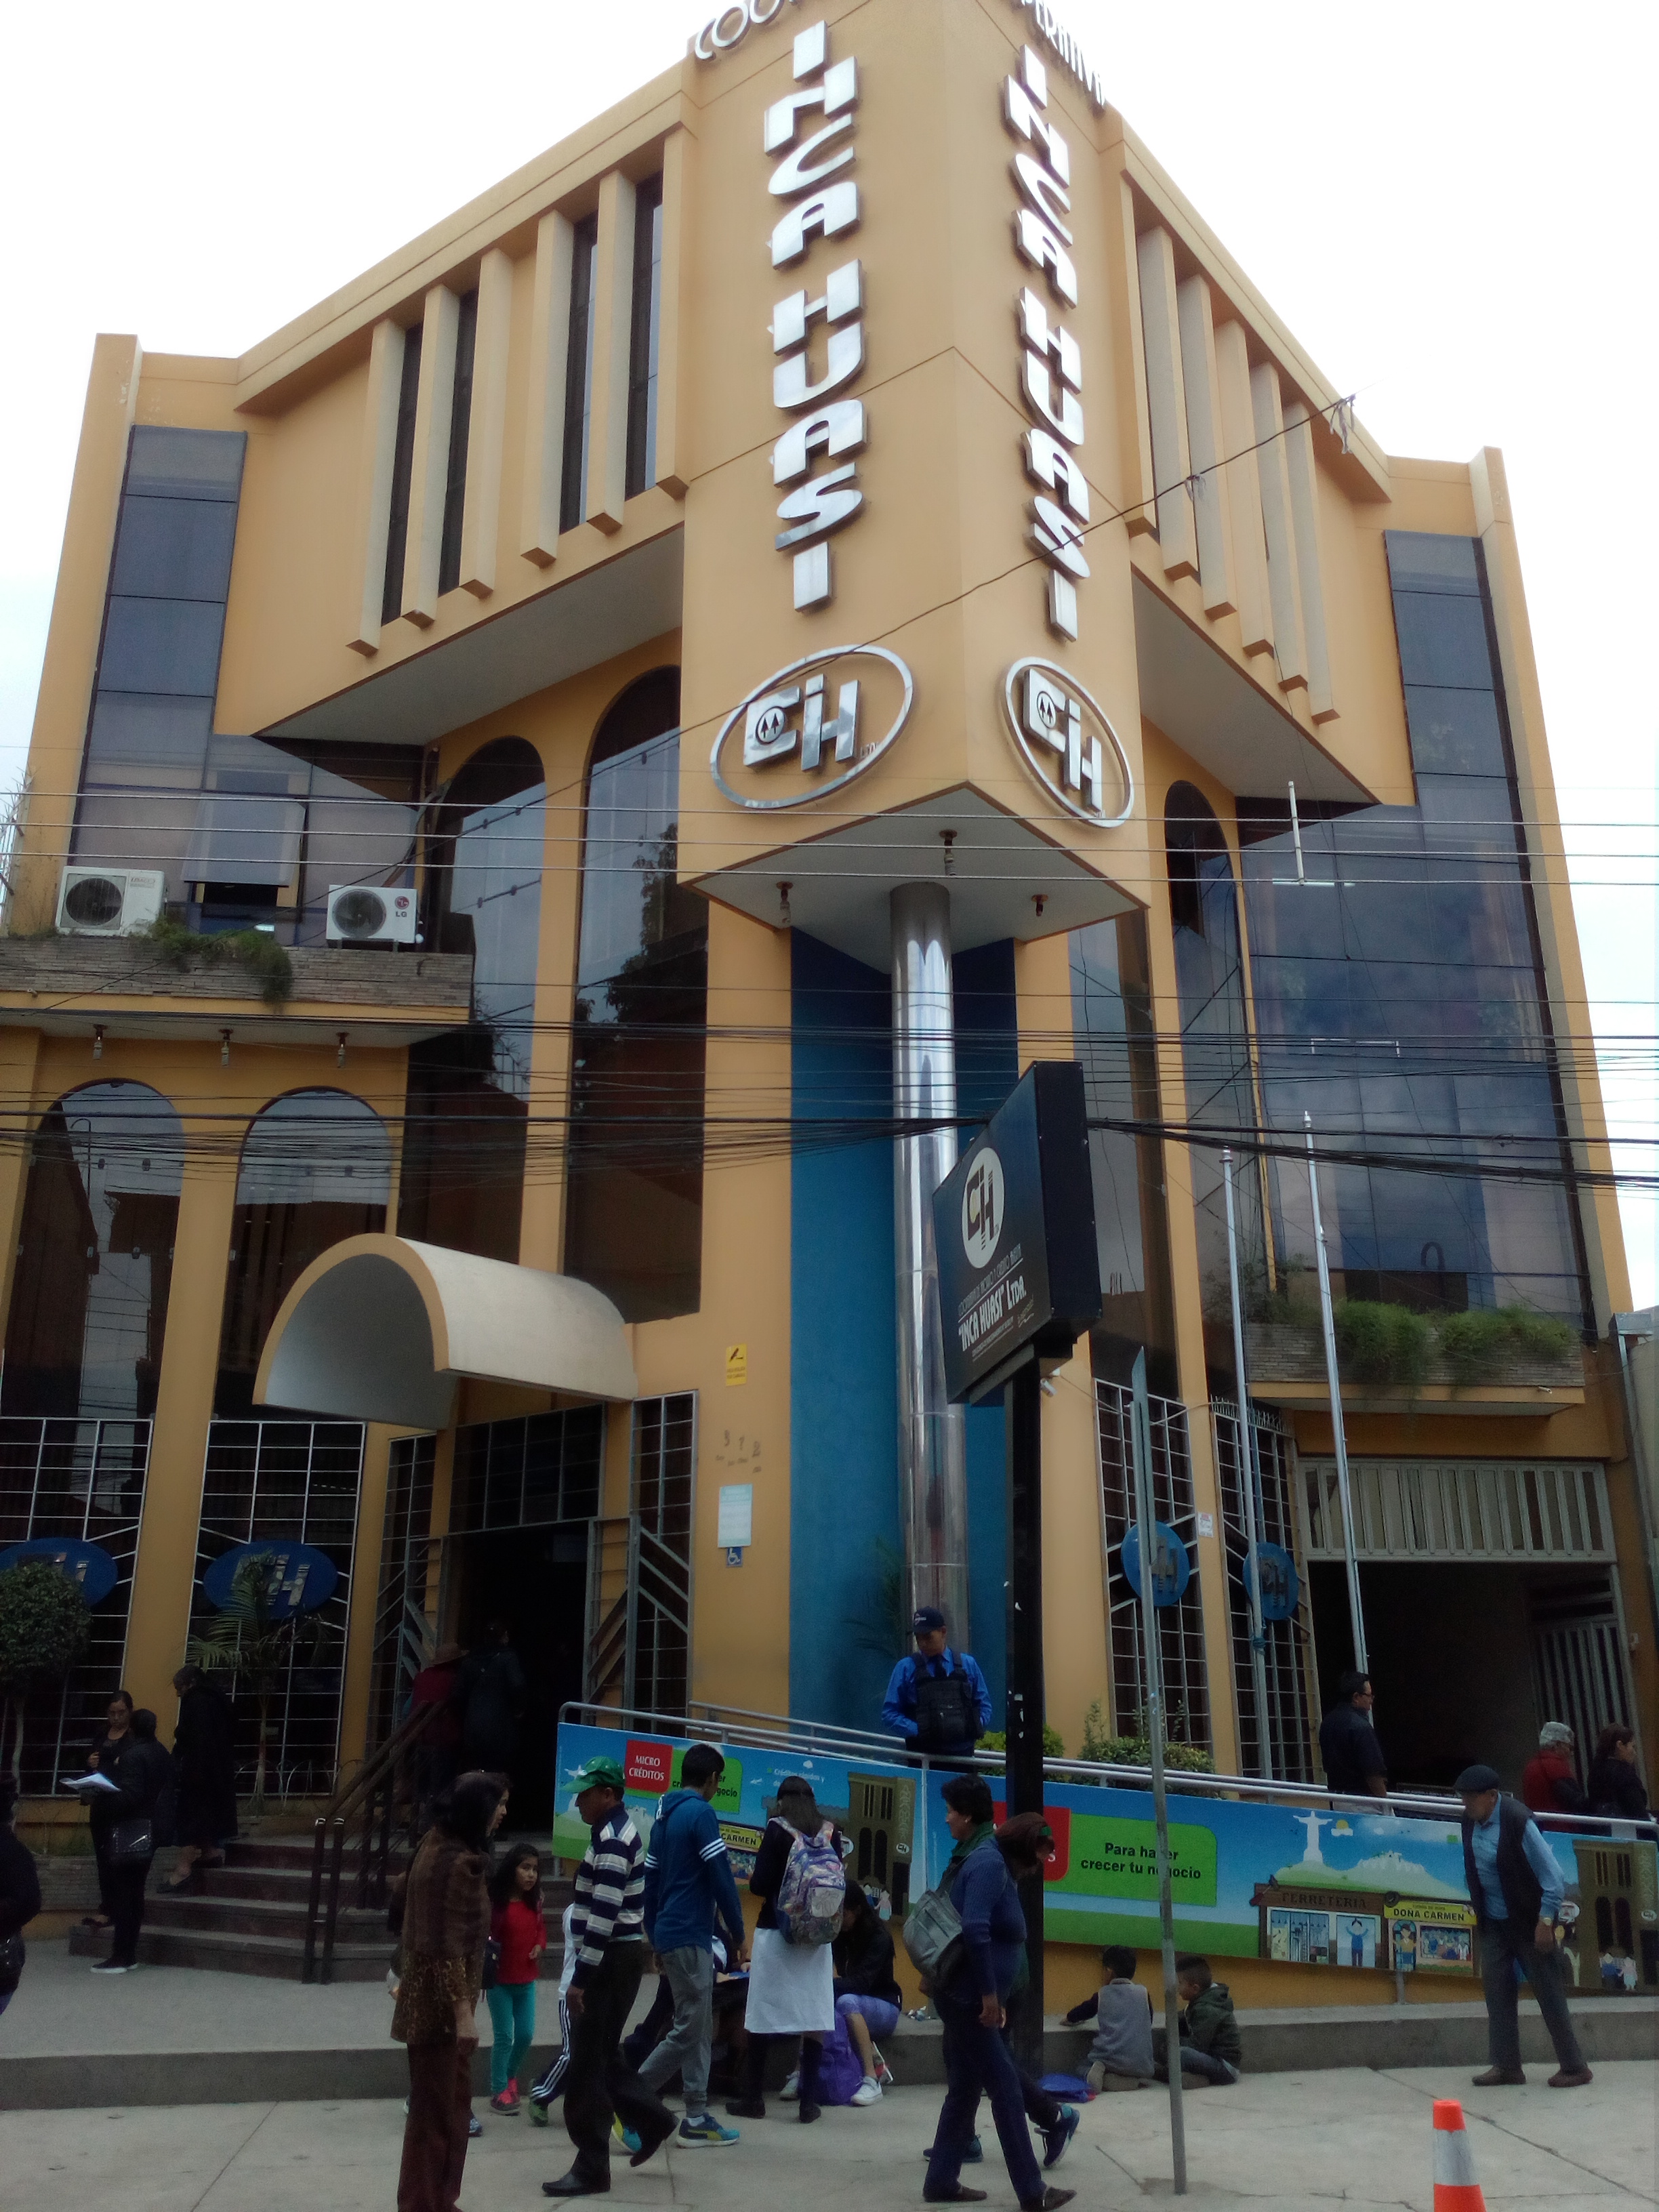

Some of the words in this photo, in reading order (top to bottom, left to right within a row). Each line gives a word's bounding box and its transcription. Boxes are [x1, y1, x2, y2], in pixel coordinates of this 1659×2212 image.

[695, 0, 798, 60] COO
[635, 1755, 661, 1767] MICRO
[628, 1766, 665, 1782] CRÉDITOS
[717, 1788, 738, 1797] gocio
[720, 1832, 756, 1845] CARMEN
[1105, 1842, 1135, 1857] Para
[1140, 1845, 1179, 1860] haer
[1080, 1859, 1125, 1872] crecer
[1130, 1862, 1143, 1874] tu
[1147, 1864, 1202, 1879] nocio
[1424, 1910, 1465, 1921] CARMEN
